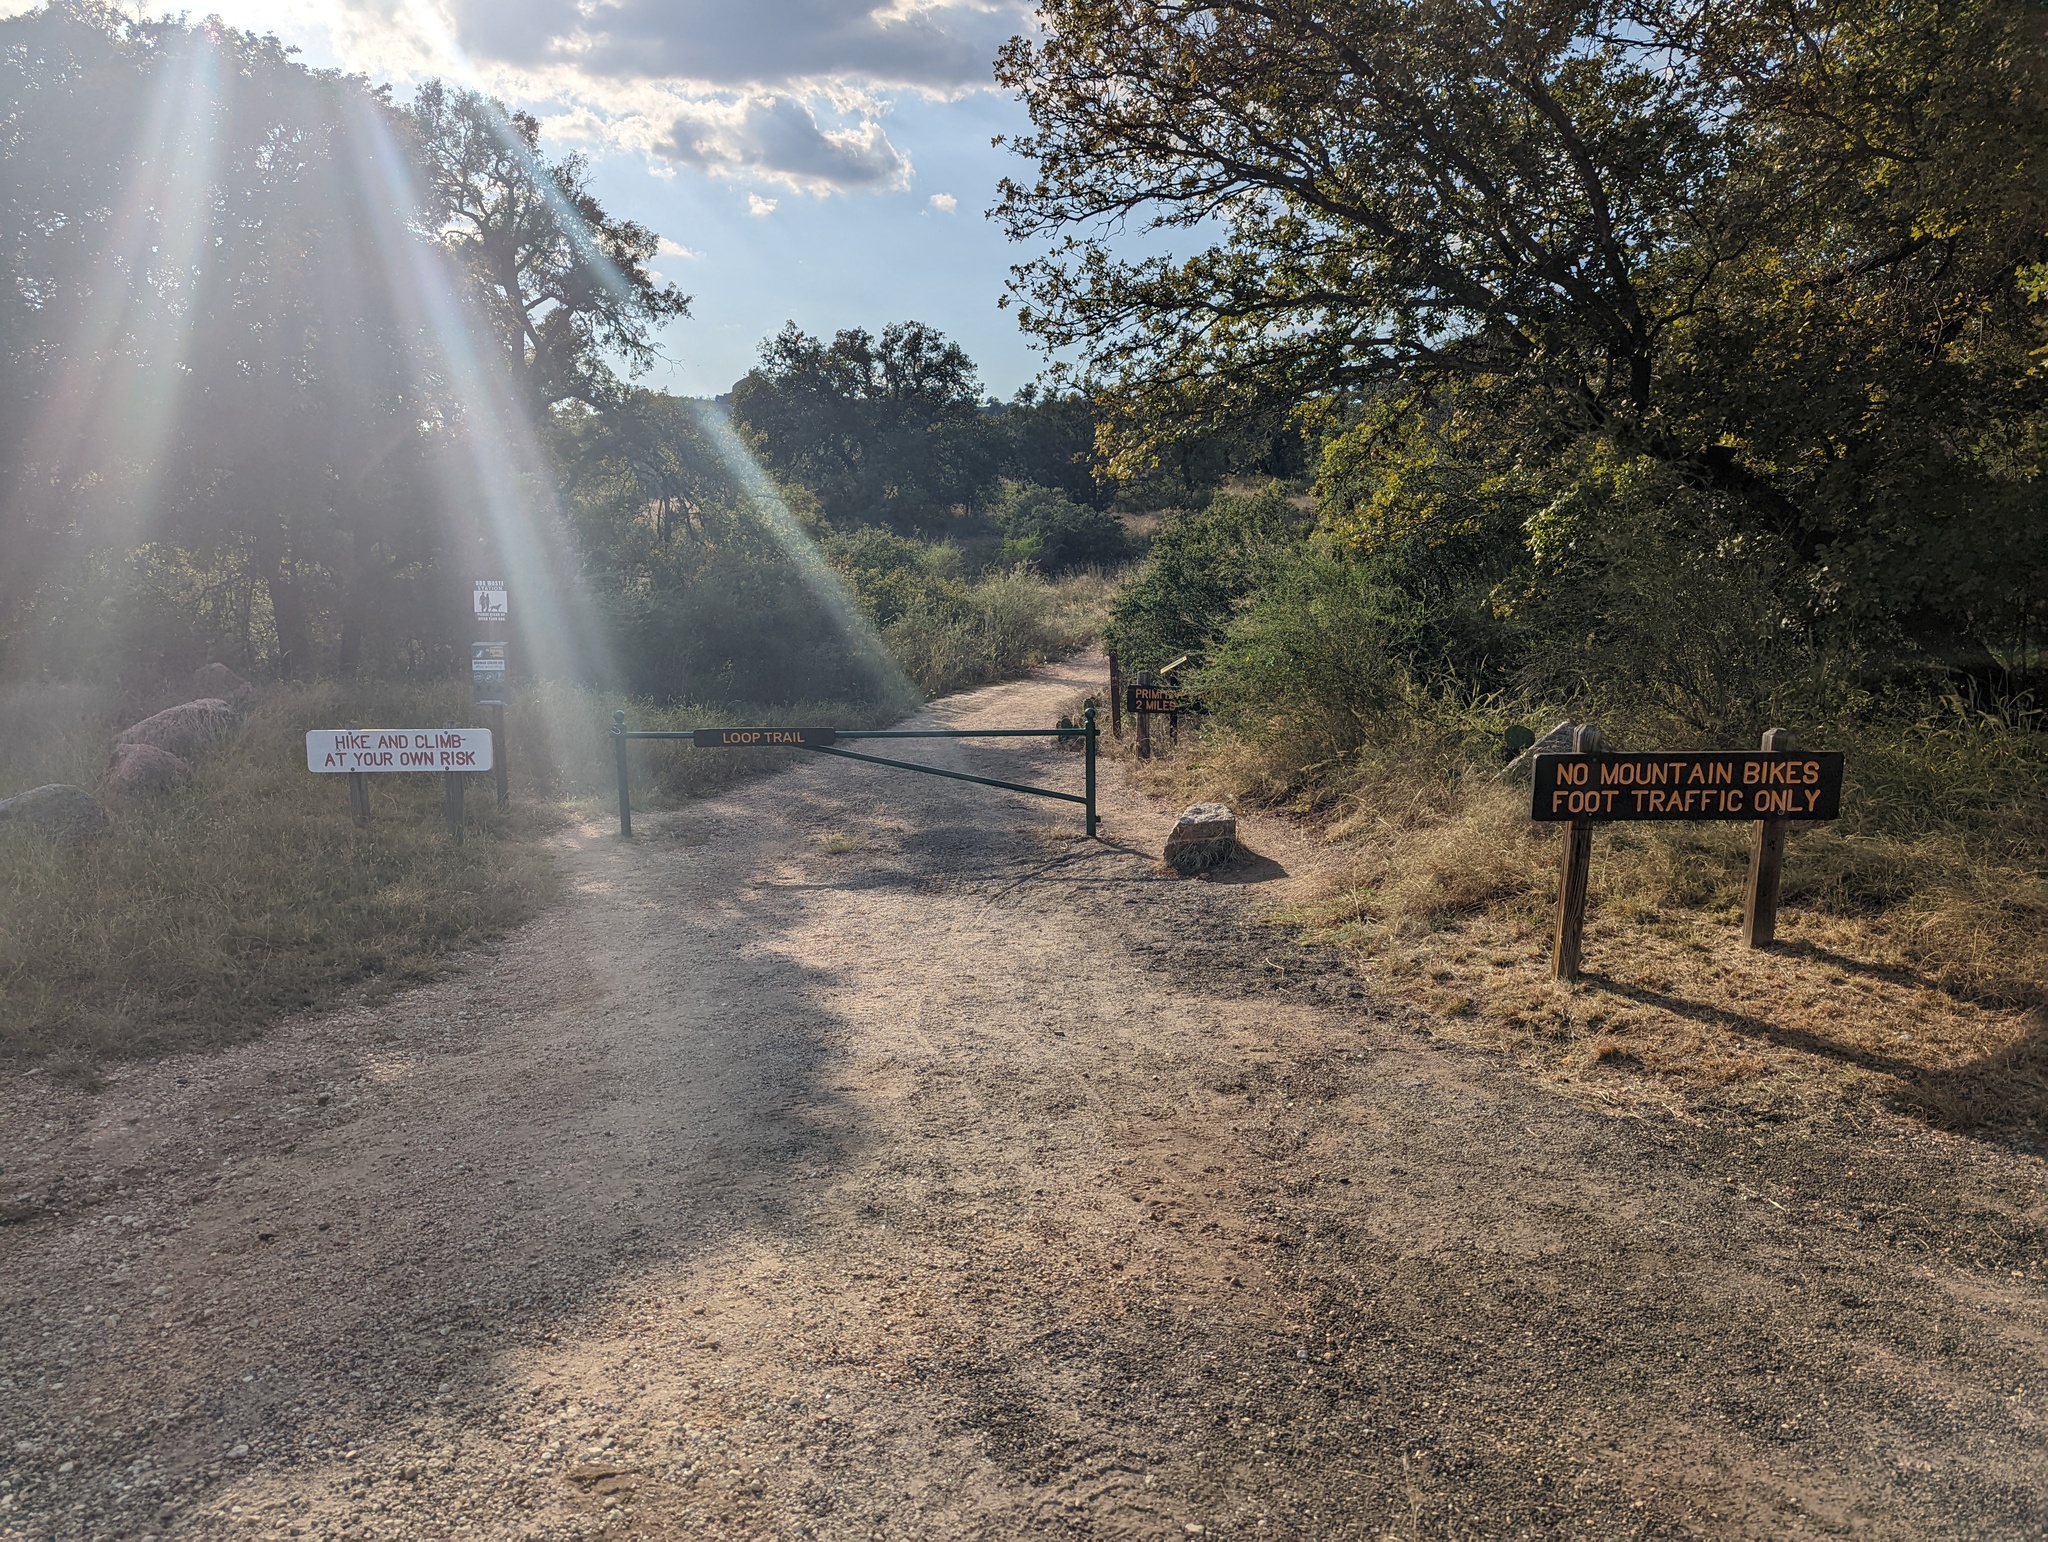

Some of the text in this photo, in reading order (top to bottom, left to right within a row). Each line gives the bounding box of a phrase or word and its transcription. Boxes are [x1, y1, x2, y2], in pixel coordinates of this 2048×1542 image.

[1135, 700, 1176, 711] 2 MILES
[335, 735, 370, 749] HIKE
[378, 735, 408, 749] AND
[723, 731, 805, 743] LOOP TRAIL
[325, 751, 476, 767] AT YOUR OWN RISK
[1556, 761, 1820, 785] NO MOUNTAIN BIKES
[1552, 789, 1822, 813] FOOT TRAFFIC ONLY
